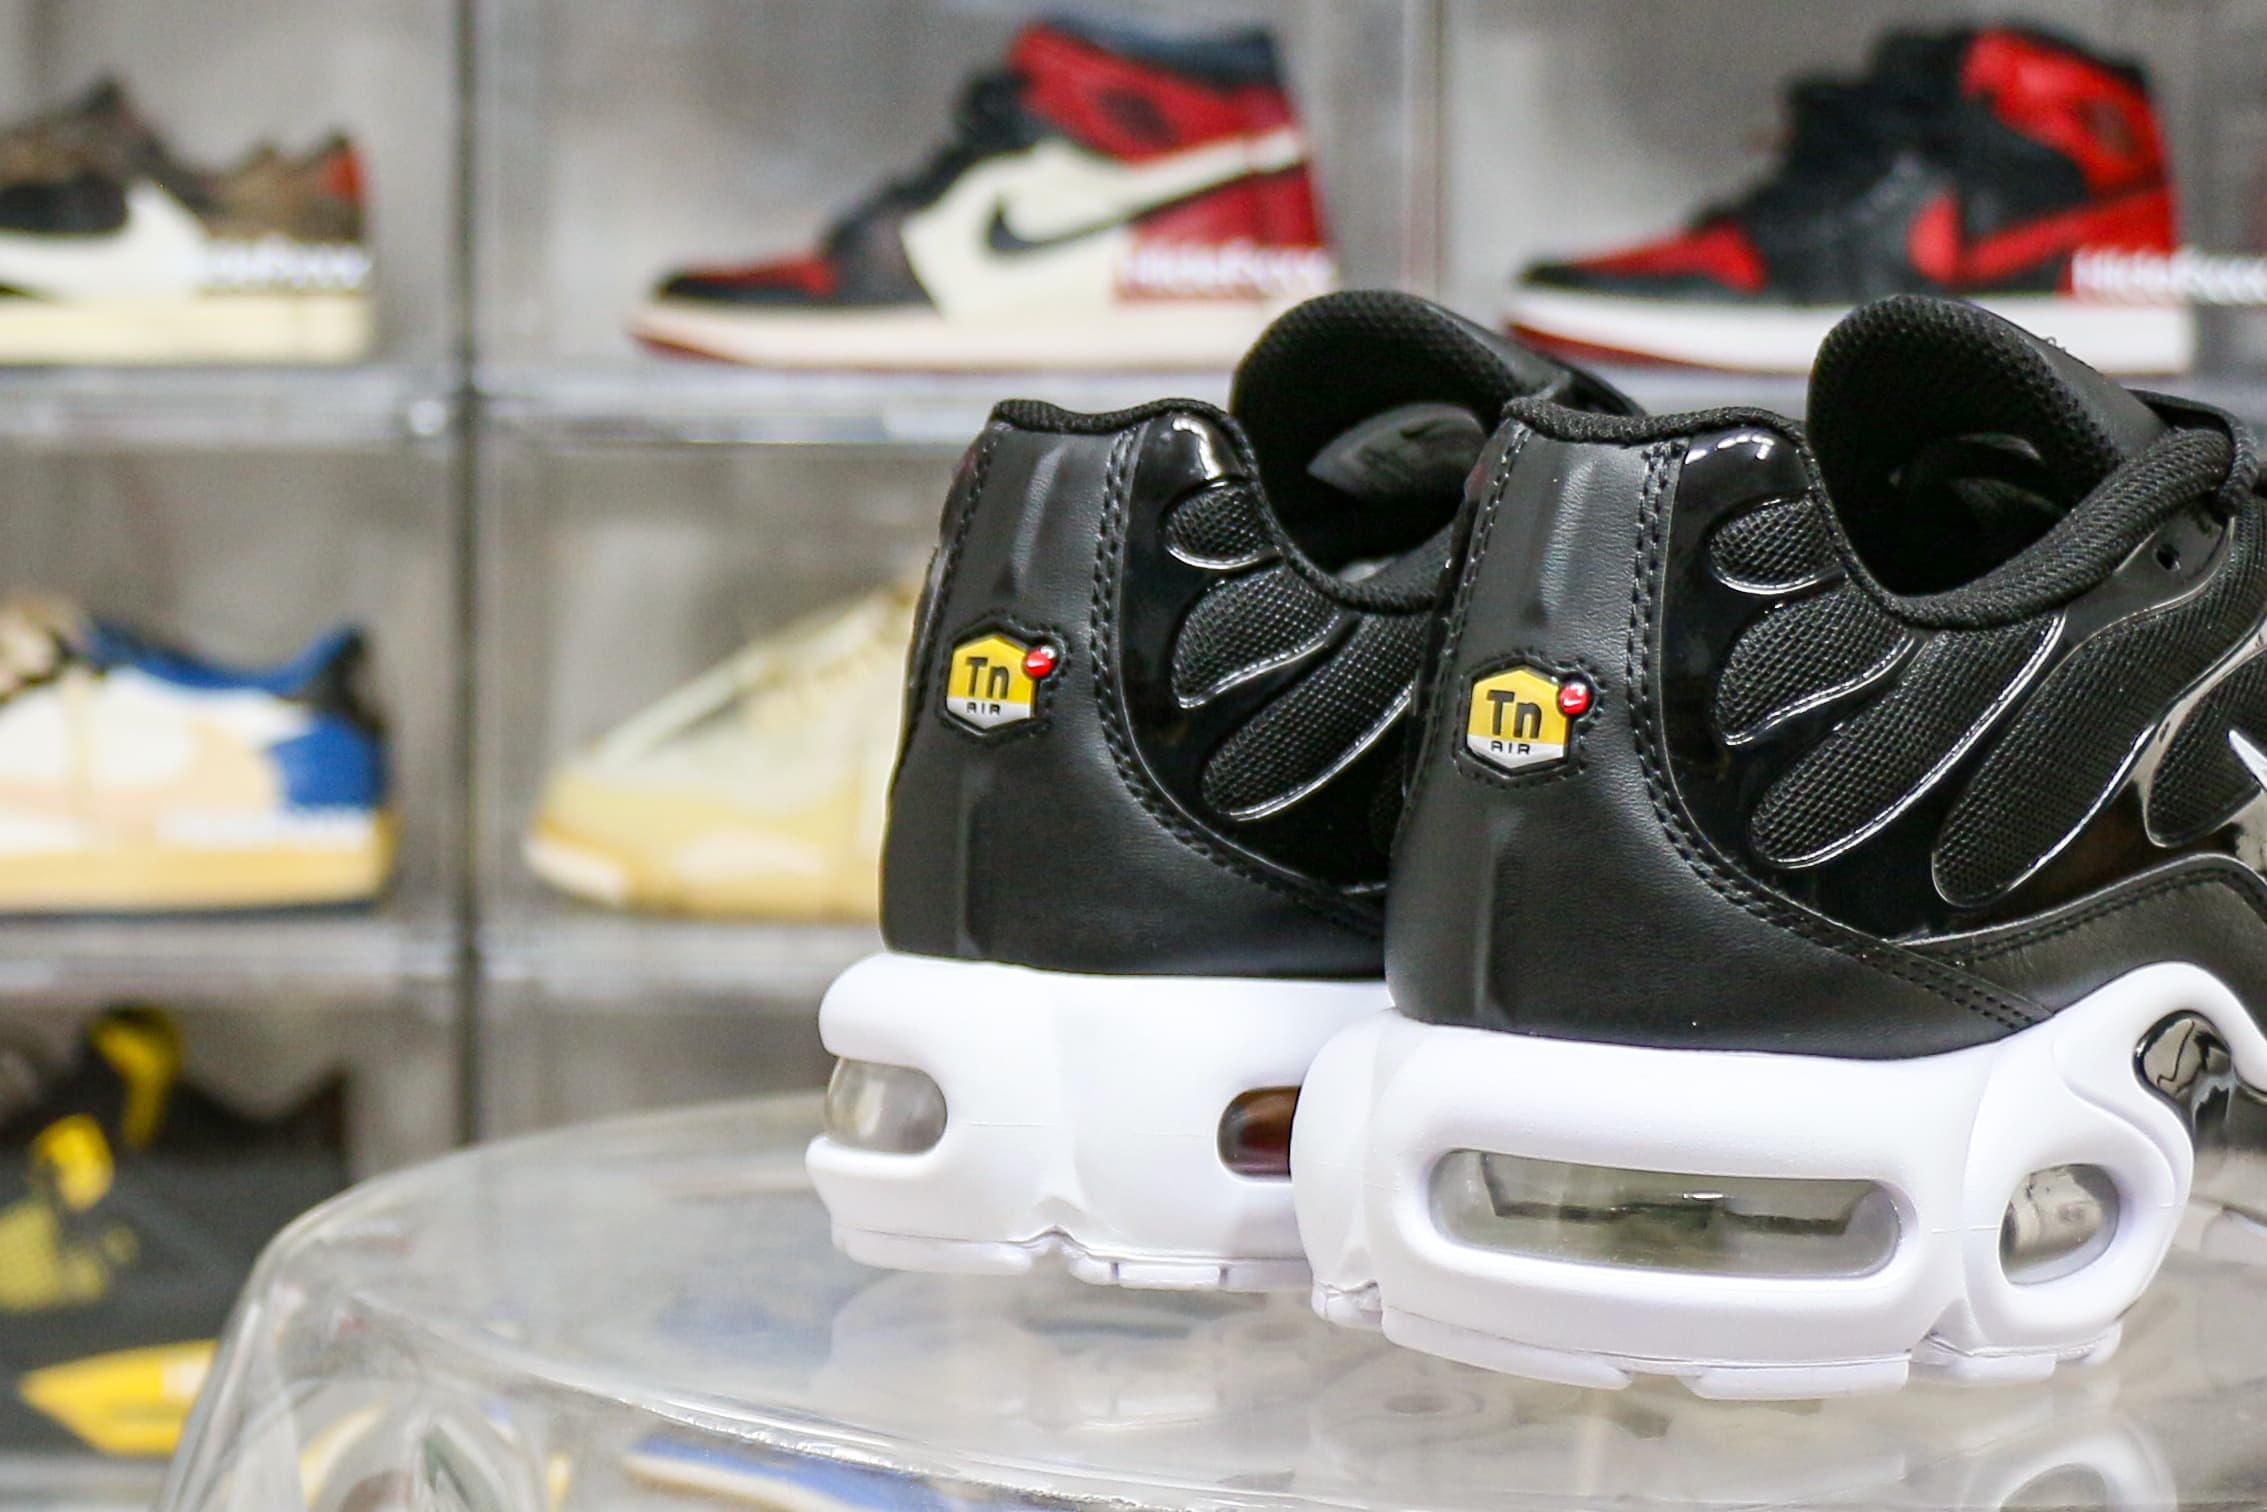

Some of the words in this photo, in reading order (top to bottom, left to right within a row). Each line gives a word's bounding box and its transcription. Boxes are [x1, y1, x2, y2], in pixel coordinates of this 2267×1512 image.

[966, 657, 1009, 699] Tn
[967, 702, 1000, 715] AIR
[1487, 689, 1542, 739] Tn
[1491, 740, 1530, 754] AIR
